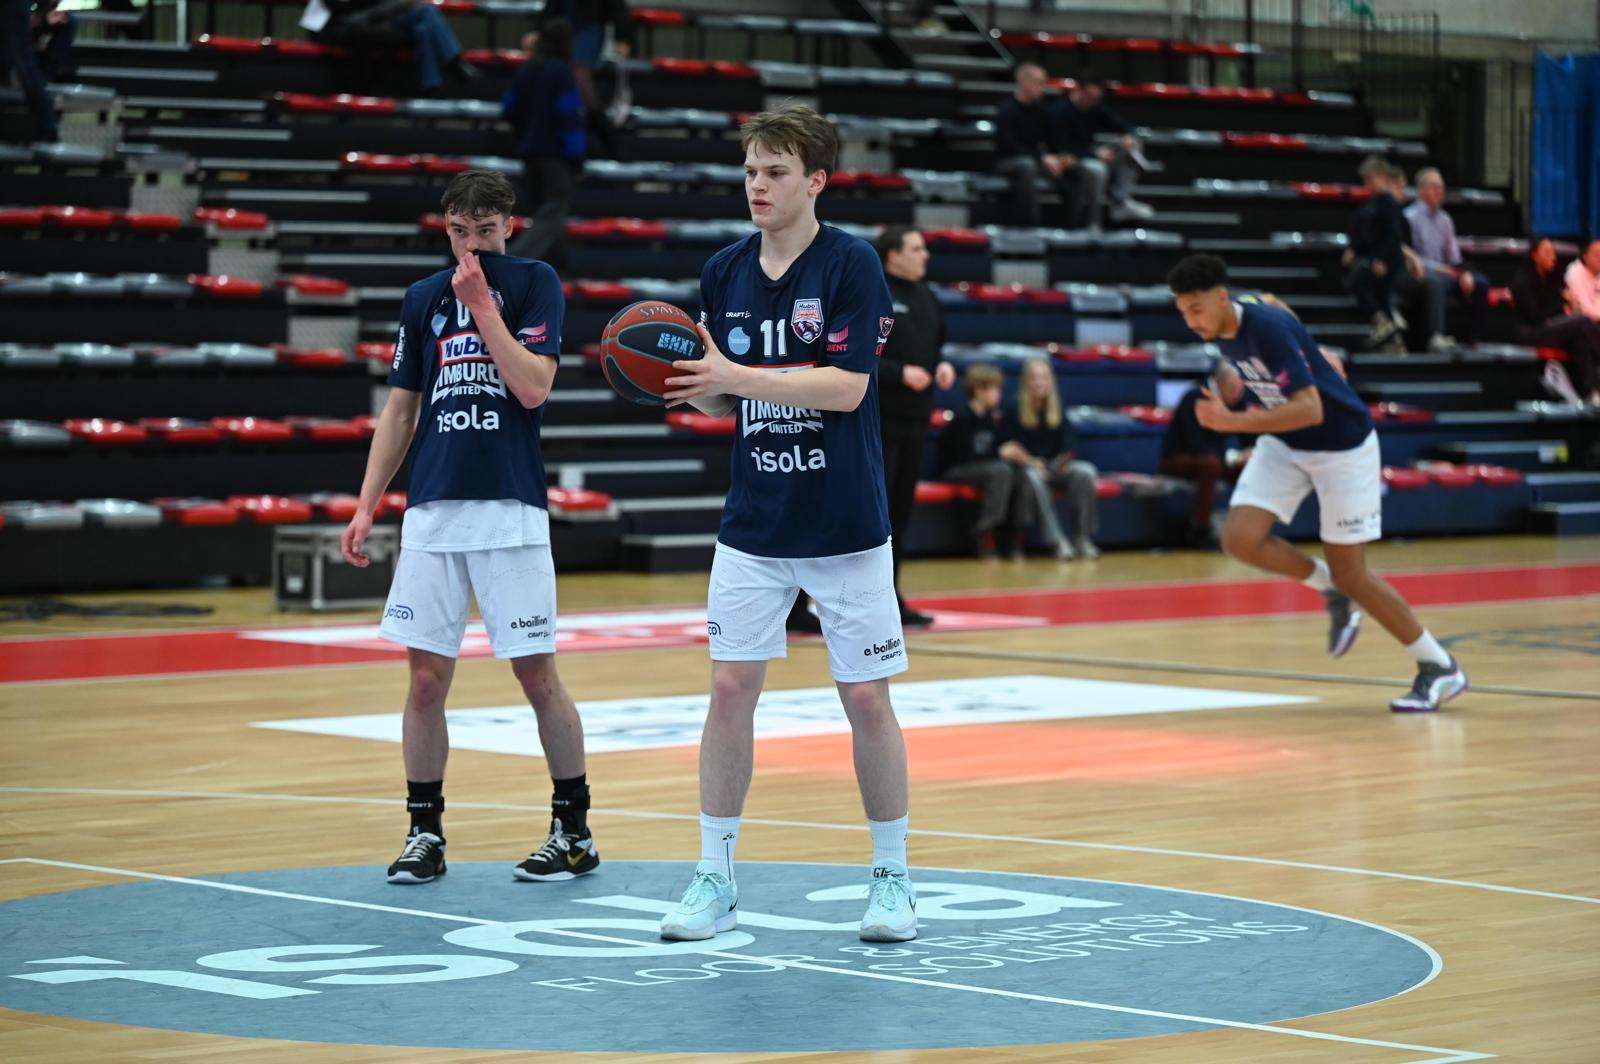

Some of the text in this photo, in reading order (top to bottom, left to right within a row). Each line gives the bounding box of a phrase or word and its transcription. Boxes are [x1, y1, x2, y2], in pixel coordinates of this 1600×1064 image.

[760, 319, 788, 357] 11
[452, 385, 481, 396] UNITED
[437, 404, 500, 433] isola
[768, 423, 803, 434] UNITED
[750, 444, 826, 473] isola
[530, 954, 853, 992] FLOOR
[903, 910, 1216, 952] ENERGY
[867, 921, 1310, 976] SOLUTIONS
